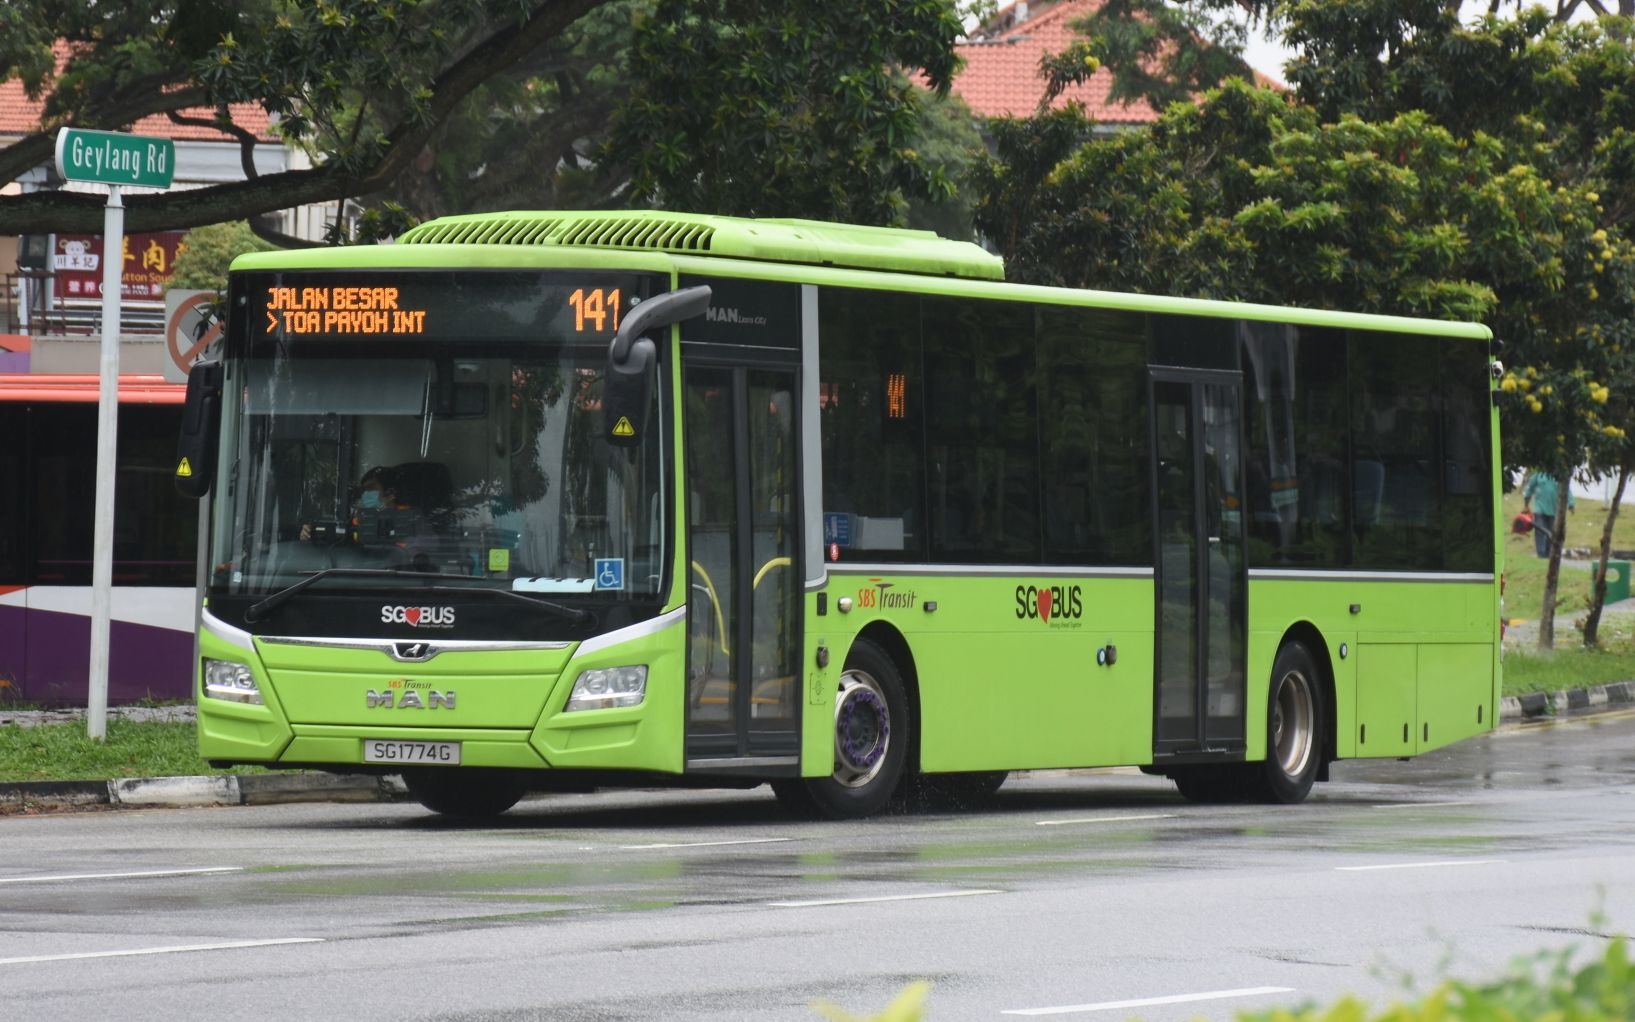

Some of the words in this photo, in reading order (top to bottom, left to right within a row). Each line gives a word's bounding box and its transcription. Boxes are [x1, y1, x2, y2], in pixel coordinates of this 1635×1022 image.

[72, 136, 140, 180] Geylang
[147, 143, 166, 174] Rd
[122, 272, 148, 282] utton
[266, 287, 329, 310] JALAN
[332, 287, 399, 310] BESAR
[569, 288, 620, 331] 141
[283, 311, 321, 334] TOA
[324, 311, 389, 334] PAYOH
[392, 311, 426, 334] INT
[706, 306, 738, 322] MAN
[857, 588, 876, 608] SBS
[875, 583, 918, 612] Transit
[402, 679, 432, 690] Transit
[367, 689, 456, 710] MAN
[374, 742, 451, 761] SG1774G
